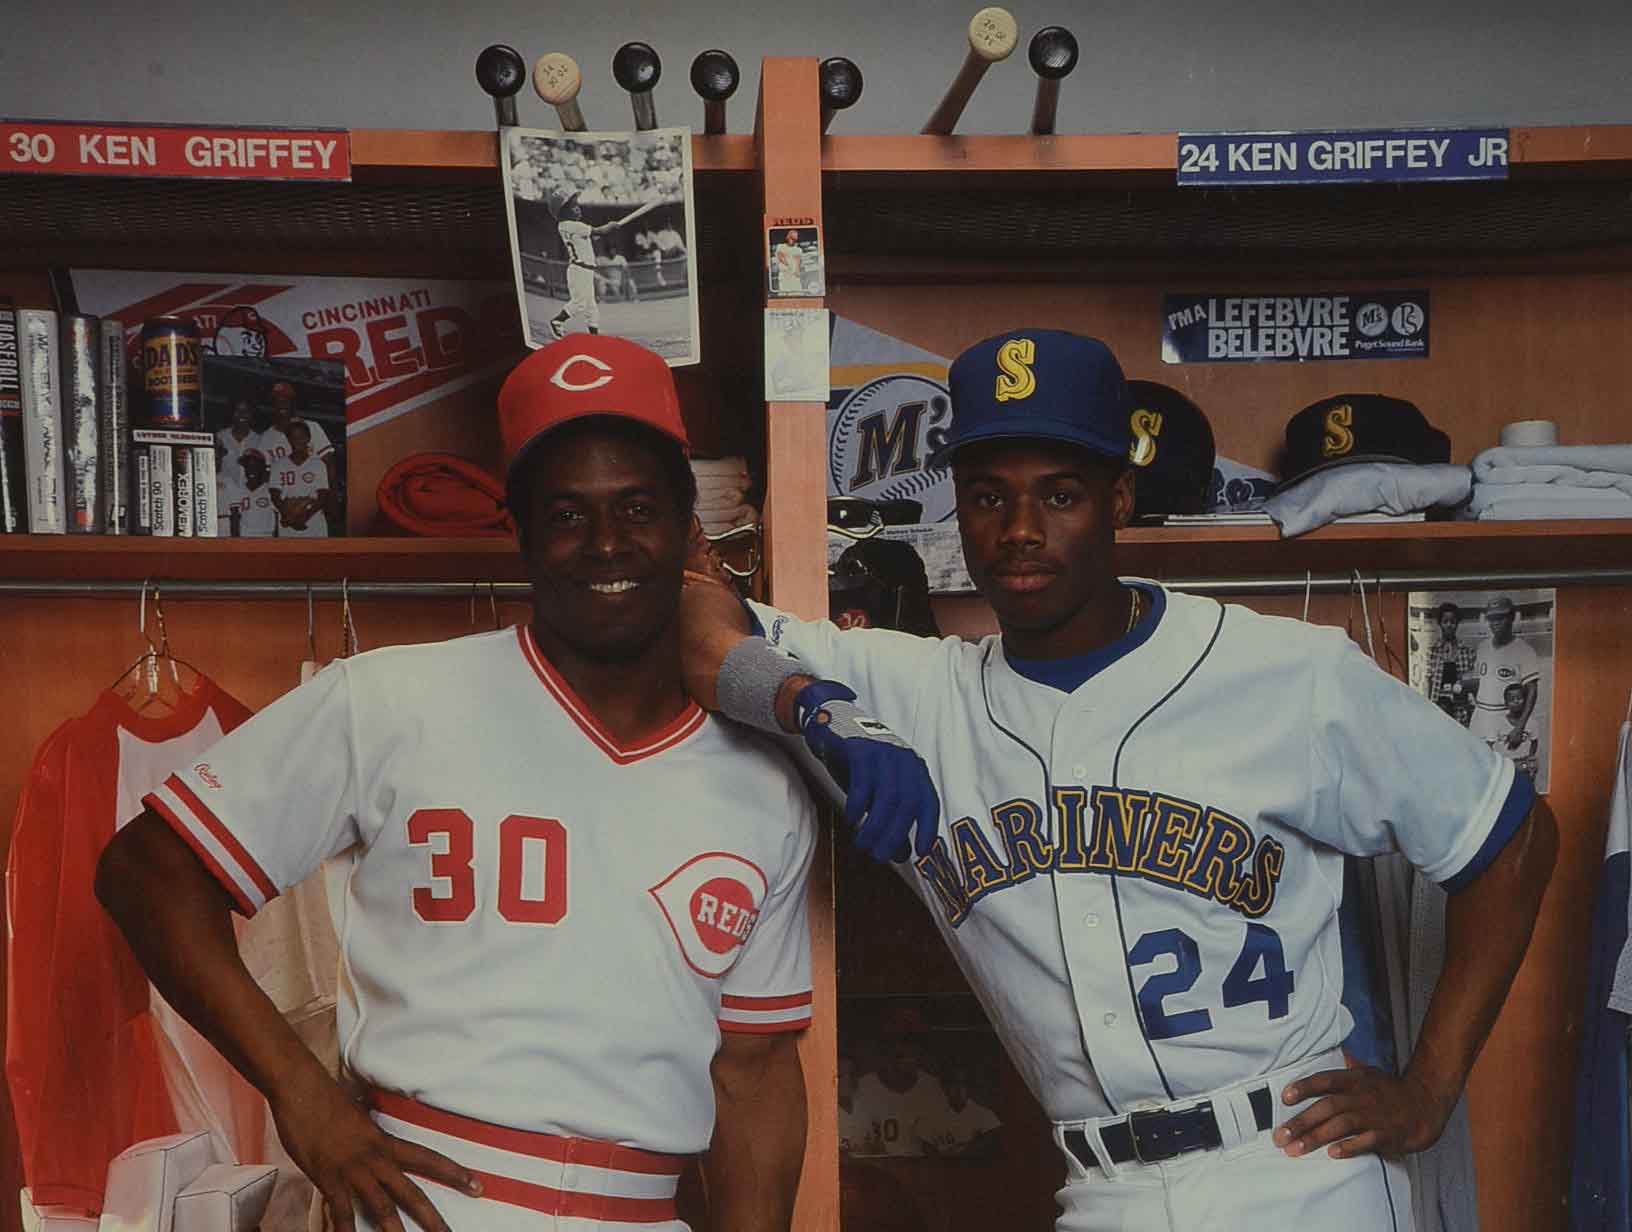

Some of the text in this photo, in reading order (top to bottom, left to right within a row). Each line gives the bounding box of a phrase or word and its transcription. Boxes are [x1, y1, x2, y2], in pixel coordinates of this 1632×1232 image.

[8, 132, 337, 170] 30 KEN GRIFFEY
[1179, 136, 1508, 174] 24 KEN GRIFFEY JR
[301, 289, 432, 330] CINCINNATI
[1207, 296, 1350, 327] LEFEBVRE
[1207, 326, 1350, 359] BELEBVRE
[994, 337, 1038, 403] S
[1128, 407, 1164, 468] S
[1321, 402, 1356, 459] S
[152, 481, 162, 496] 90
[176, 472, 189, 537] MEMOREX
[196, 482, 206, 498] 90
[151, 496, 164, 530] Scotch
[198, 498, 209, 533] Scotch
[406, 807, 569, 925] 30
[916, 786, 1285, 928] MARINERS
[696, 892, 760, 942] REDS
[1127, 922, 1295, 1041] 24
